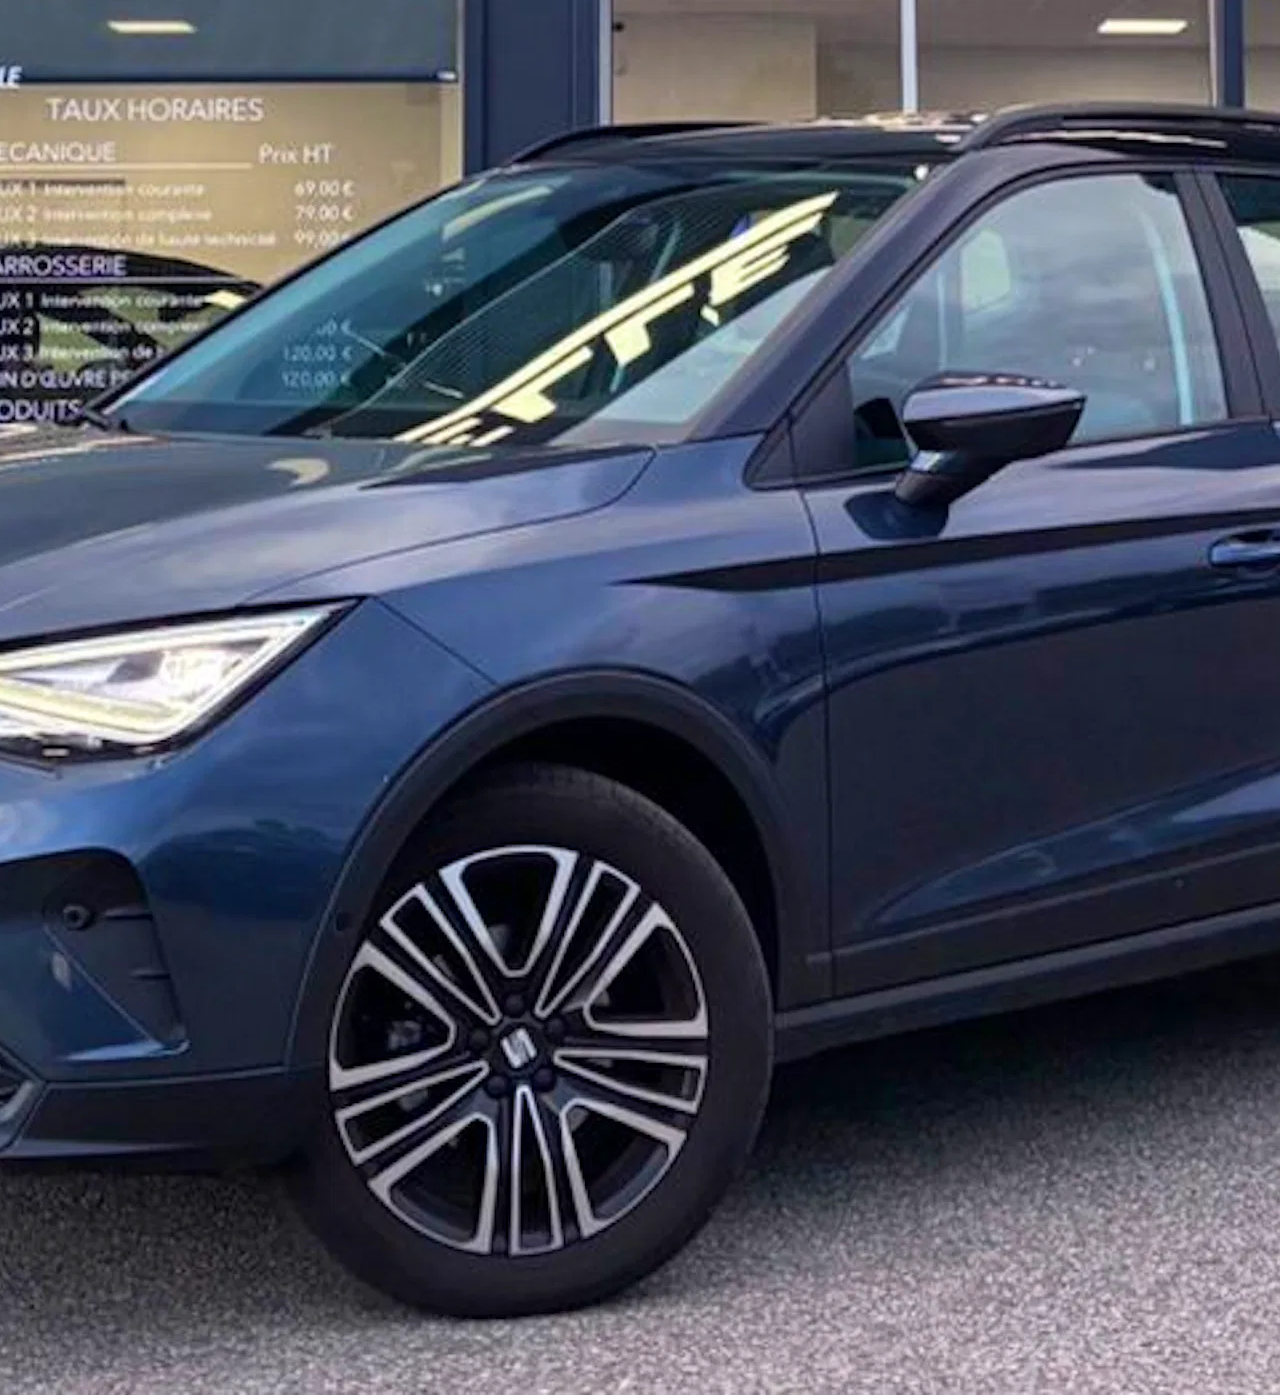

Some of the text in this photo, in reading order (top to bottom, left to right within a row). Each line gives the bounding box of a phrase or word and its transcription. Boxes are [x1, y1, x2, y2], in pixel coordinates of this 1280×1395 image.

[46, 97, 264, 122] TAUX HORAIRES
[259, 143, 297, 164] Prix
[303, 143, 333, 164] HT
[25, 292, 34, 309] 1
[40, 292, 132, 309] Intervention
[23, 318, 34, 335] 2
[23, 344, 34, 361] 3
[133, 344, 154, 360] de
